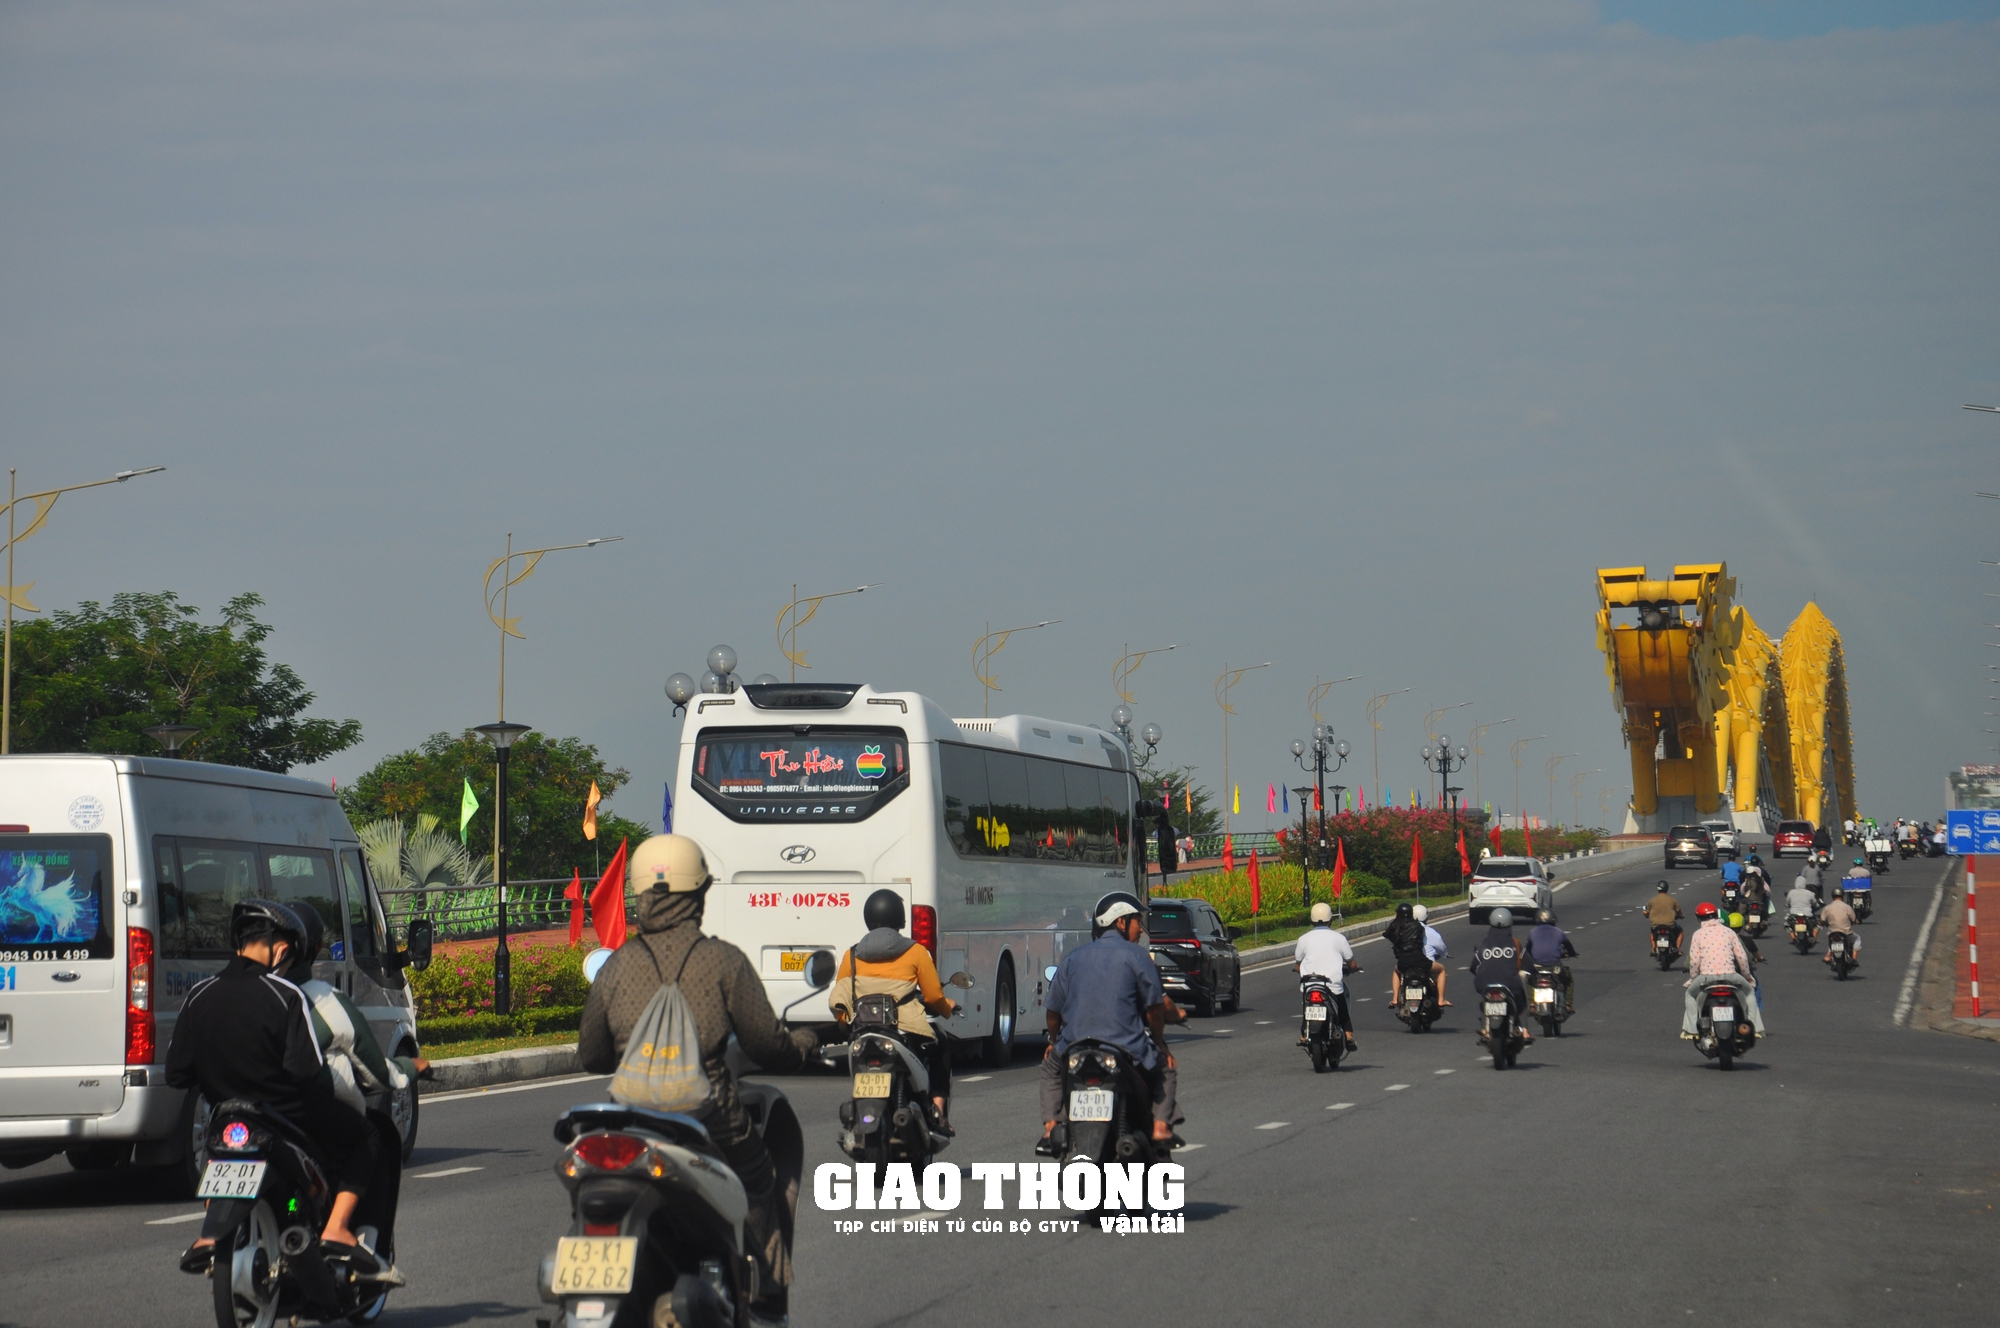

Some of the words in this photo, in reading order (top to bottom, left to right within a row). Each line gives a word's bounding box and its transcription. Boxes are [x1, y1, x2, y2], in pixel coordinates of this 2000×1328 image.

[760, 749, 801, 777] Thu
[740, 806, 857, 815] UNIVERSE
[12, 855, 23, 866] XE
[32, 950, 59, 961] 011
[63, 949, 90, 960] 499
[791, 953, 807, 962] 43F
[78, 1080, 100, 1088] ABS
[213, 1164, 256, 1178] 92-D1
[203, 1180, 257, 1195] 141.87
[570, 1242, 622, 1262] 43-K1
